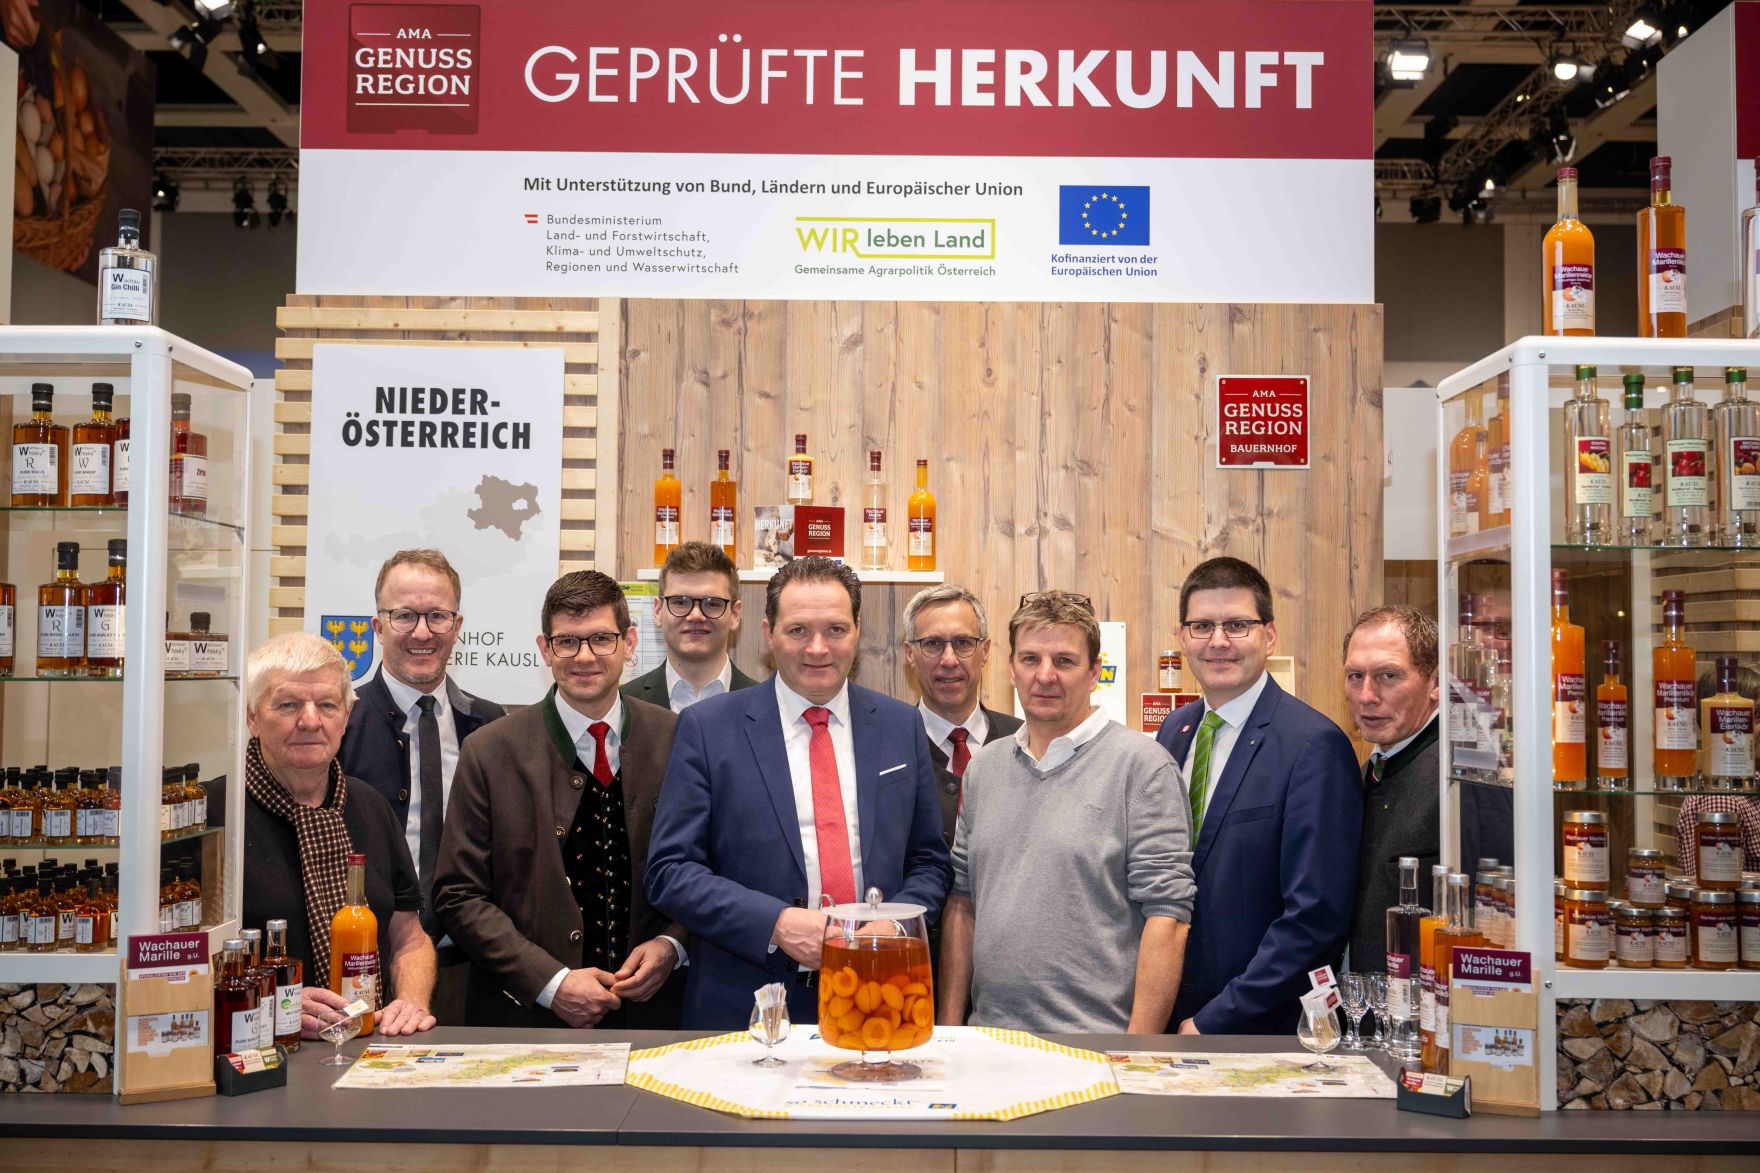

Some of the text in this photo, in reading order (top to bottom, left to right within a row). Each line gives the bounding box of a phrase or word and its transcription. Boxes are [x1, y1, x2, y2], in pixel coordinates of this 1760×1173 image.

[397, 29, 432, 39] AMA
[355, 48, 472, 69] GENUSS
[525, 34, 1324, 108] GEPRÜFTE HERKUNFT
[356, 74, 471, 95] REGION
[524, 178, 1023, 198] Mit Unterstützung von Bund, Ländern und Europäischer Union
[547, 213, 662, 226] Bundesministerium
[546, 229, 710, 244] Land- und Forstwirtschaft,
[797, 227, 985, 254] WIR leben Land
[546, 245, 706, 259] Klima- und Umweltschutz,
[1051, 253, 1158, 264] Kofinanziert von der
[546, 261, 739, 275] Regionen und Wasserwirtschaft
[795, 263, 996, 278] Gemeinsame Agrarpolitik Österreich
[1051, 266, 1158, 278] Europäischen Union
[375, 387, 500, 415] NIEDER-
[1252, 390, 1276, 398] AMA
[1224, 403, 1303, 417] GENUSS
[342, 411, 531, 449] ÖSTERREICH
[1225, 420, 1302, 435] REGION
[1230, 444, 1298, 453] BAUERNHOF
[755, 519, 793, 531] HERKUNFT
[458, 631, 504, 646] NHOF
[486, 652, 540, 667] KAUSL
[1143, 707, 1171, 715] GENUSS
[139, 940, 200, 952] Wachauer
[140, 950, 180, 962] Marille
[1460, 953, 1522, 967] Wachauer
[1461, 963, 1502, 976] Marille
